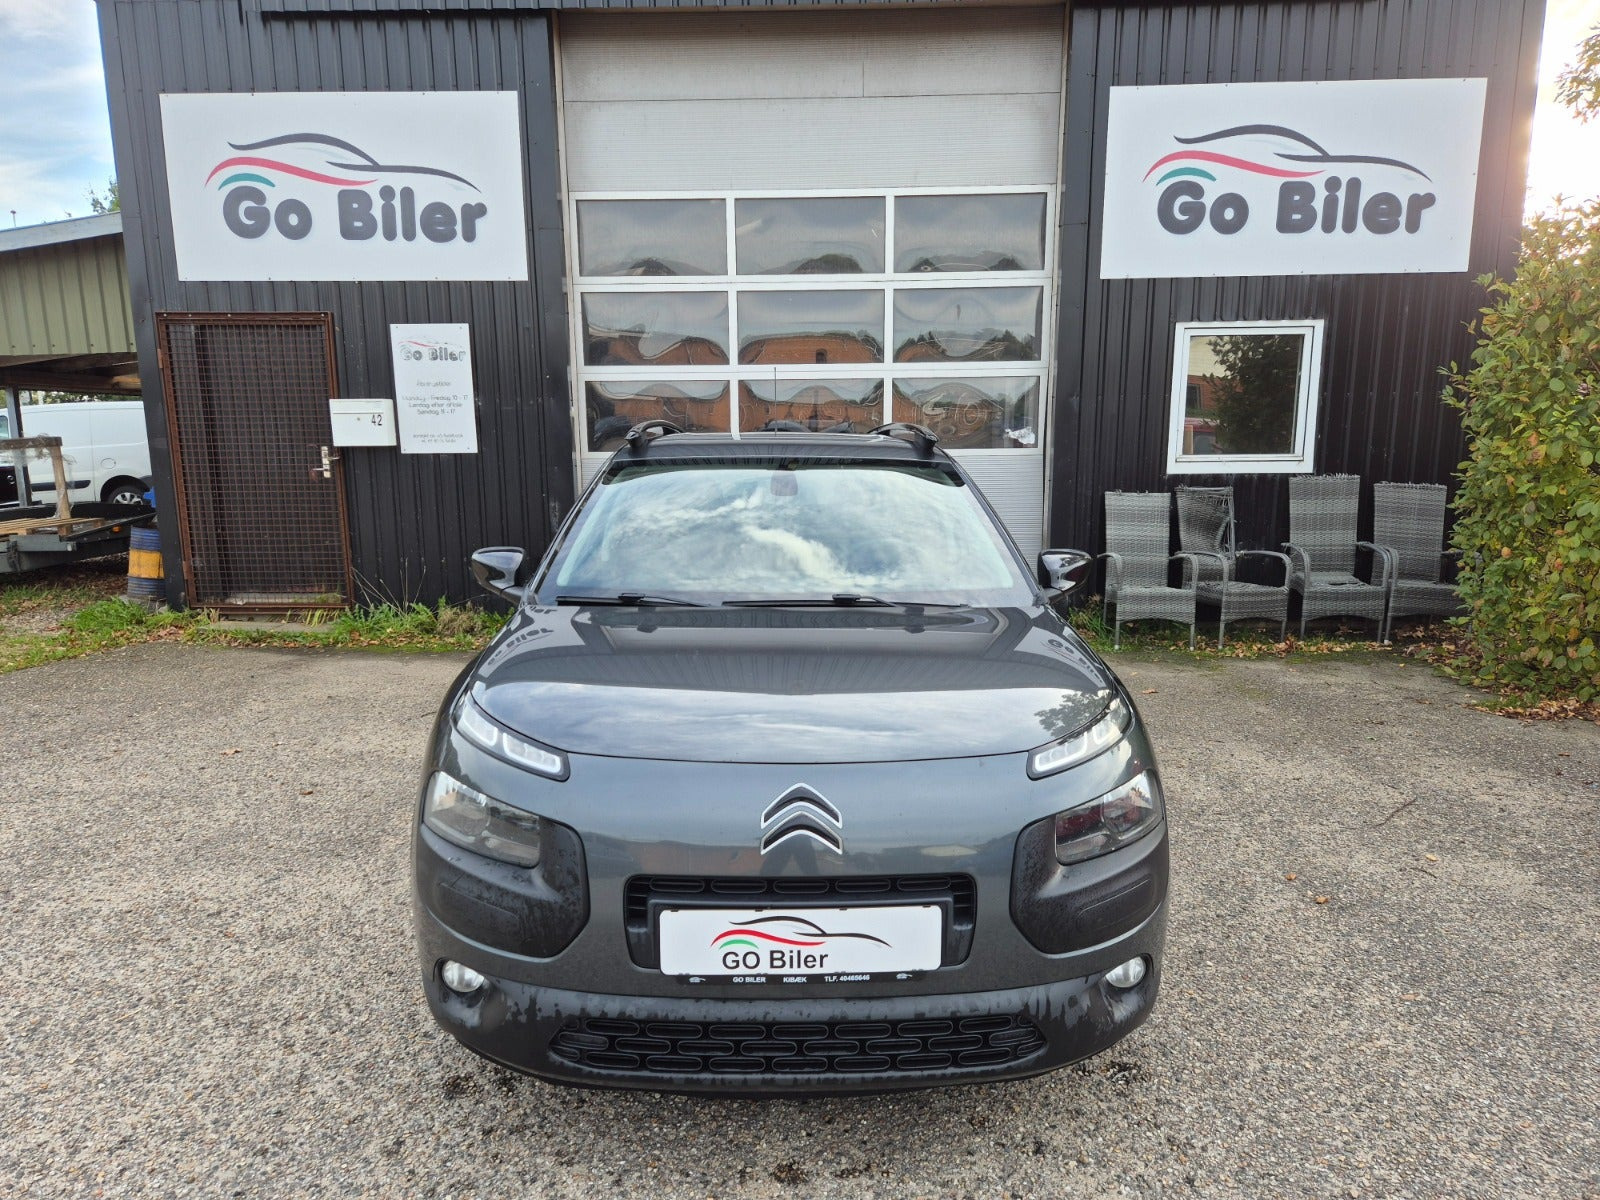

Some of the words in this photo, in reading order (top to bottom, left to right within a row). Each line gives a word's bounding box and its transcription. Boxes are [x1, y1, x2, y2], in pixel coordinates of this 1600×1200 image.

[1157, 180, 1250, 235] Go
[1275, 175, 1436, 235] Biler
[223, 185, 313, 240] Go
[337, 185, 488, 243] Biler
[400, 347, 422, 361] Go
[428, 346, 466, 361] Biler
[371, 414, 383, 427] 42
[769, 950, 829, 969] Biler
[824, 975, 838, 983] TLF.
